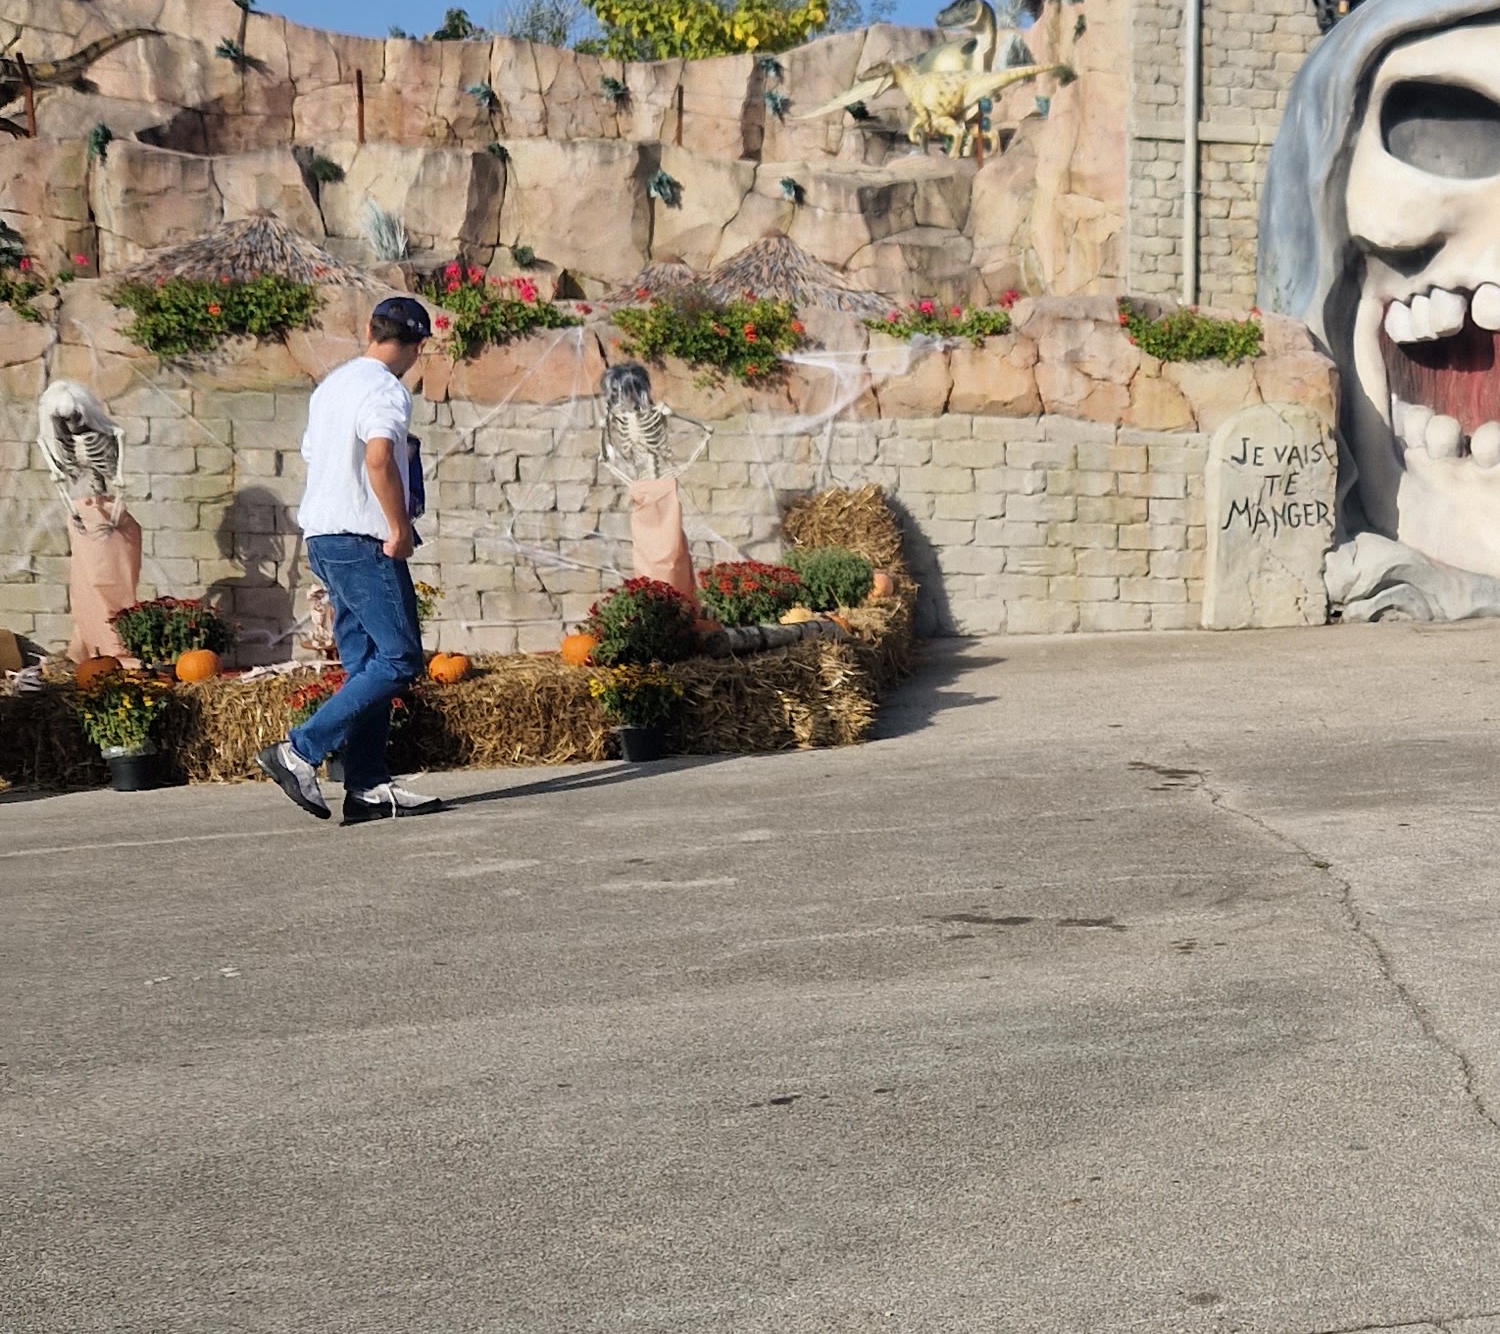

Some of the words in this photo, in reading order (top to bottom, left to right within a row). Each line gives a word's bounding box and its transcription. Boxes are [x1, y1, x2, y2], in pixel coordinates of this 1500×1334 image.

[1231, 437, 1265, 466] JE
[1274, 442, 1323, 469] VAIS
[1264, 471, 1300, 497] TE
[1221, 496, 1334, 538] MANGER
